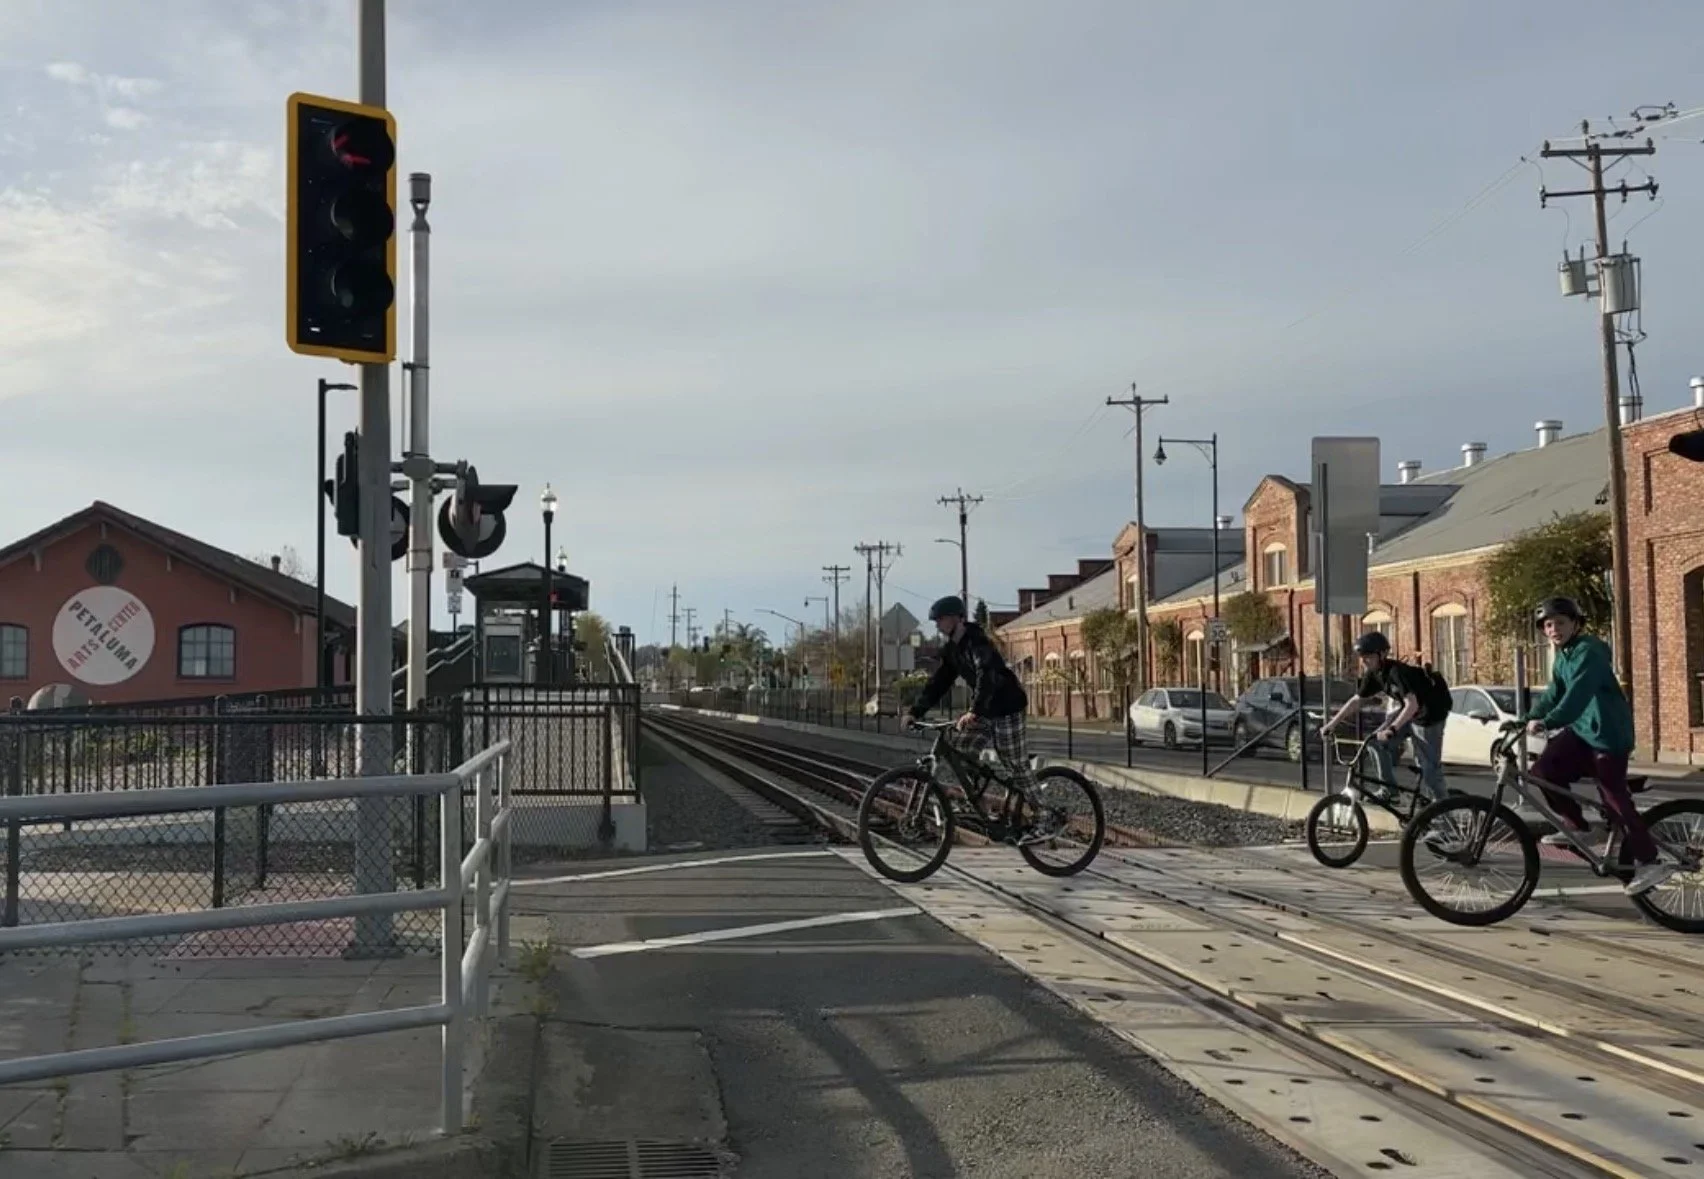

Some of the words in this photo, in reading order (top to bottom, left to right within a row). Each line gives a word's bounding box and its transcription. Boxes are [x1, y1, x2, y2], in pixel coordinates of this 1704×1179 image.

[67, 639, 100, 670] ARTS
[107, 600, 141, 632] CENTER
[68, 600, 138, 670] PETALUMA
